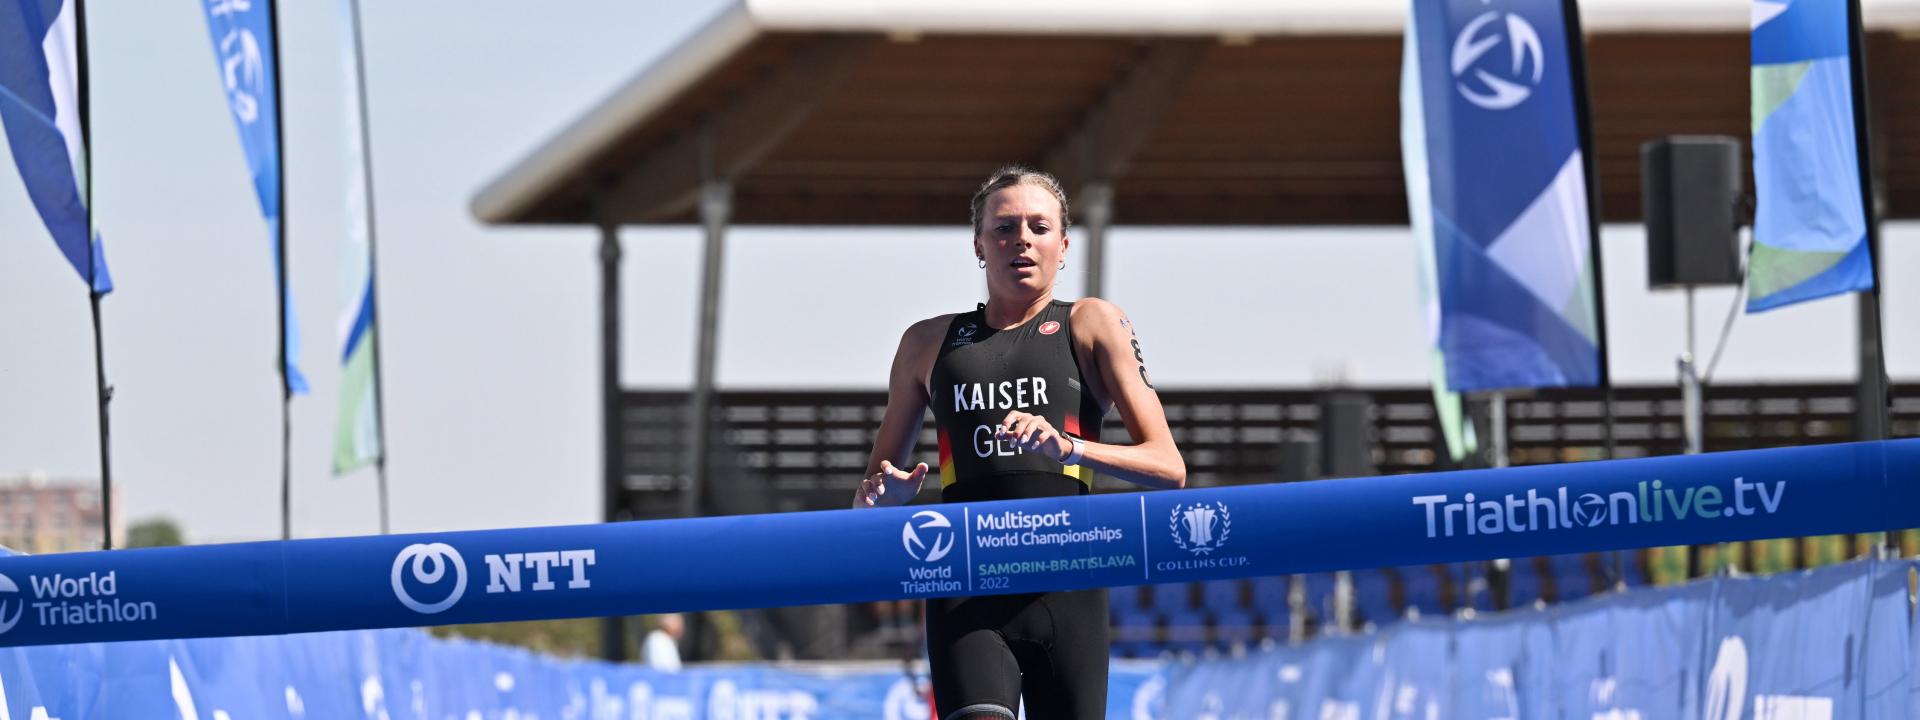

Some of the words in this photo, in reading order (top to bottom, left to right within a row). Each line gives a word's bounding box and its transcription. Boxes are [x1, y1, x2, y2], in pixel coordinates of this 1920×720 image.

[954, 376, 1049, 412] KAISER
[973, 424, 1023, 458] GE
[1412, 476, 1786, 538] Triathlonlive.tv
[976, 510, 1071, 531] Multisport
[976, 532, 1019, 548] World
[1021, 526, 1123, 547] Championships
[486, 549, 596, 593] NTT
[909, 566, 952, 580] World
[978, 554, 1137, 576] SAMORIN-BRATISLAVA
[1156, 559, 1216, 571] COLLINS
[30, 570, 117, 599] World
[900, 579, 962, 594] Triathlon
[979, 577, 1010, 590] 2022
[32, 598, 157, 626] Triathlon
